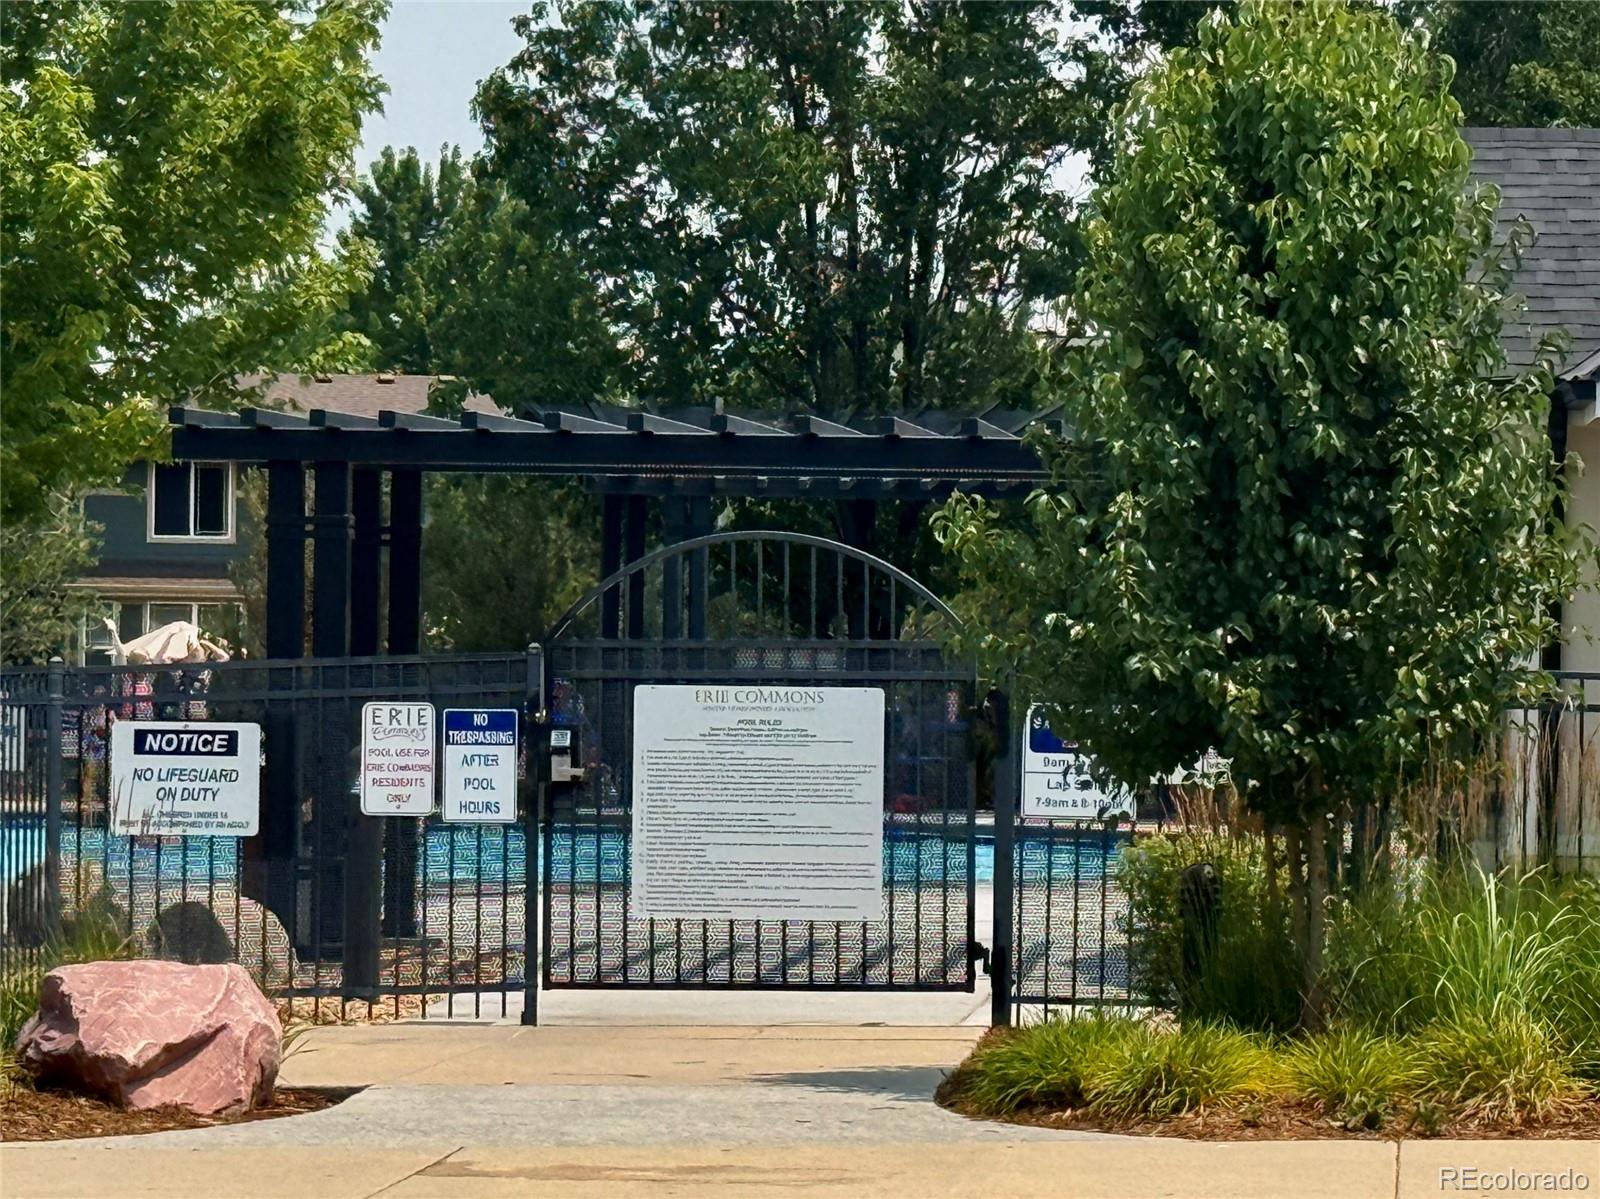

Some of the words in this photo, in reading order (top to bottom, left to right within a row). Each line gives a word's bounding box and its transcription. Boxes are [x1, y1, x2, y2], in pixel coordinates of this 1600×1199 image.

[734, 689, 825, 704] COMMONS
[372, 707, 428, 726] ERIE
[473, 713, 489, 727] NO
[144, 733, 229, 752] NOTICE
[449, 730, 514, 744] TRESPASSING
[462, 754, 499, 767] AFTER
[133, 767, 154, 781] NO
[157, 767, 239, 783] LIFEGUARD
[372, 777, 425, 788] RESIDENTS
[464, 777, 496, 790] POOL
[156, 786, 178, 802] ON
[181, 787, 220, 802] DUTY
[459, 801, 500, 815] HOURS
